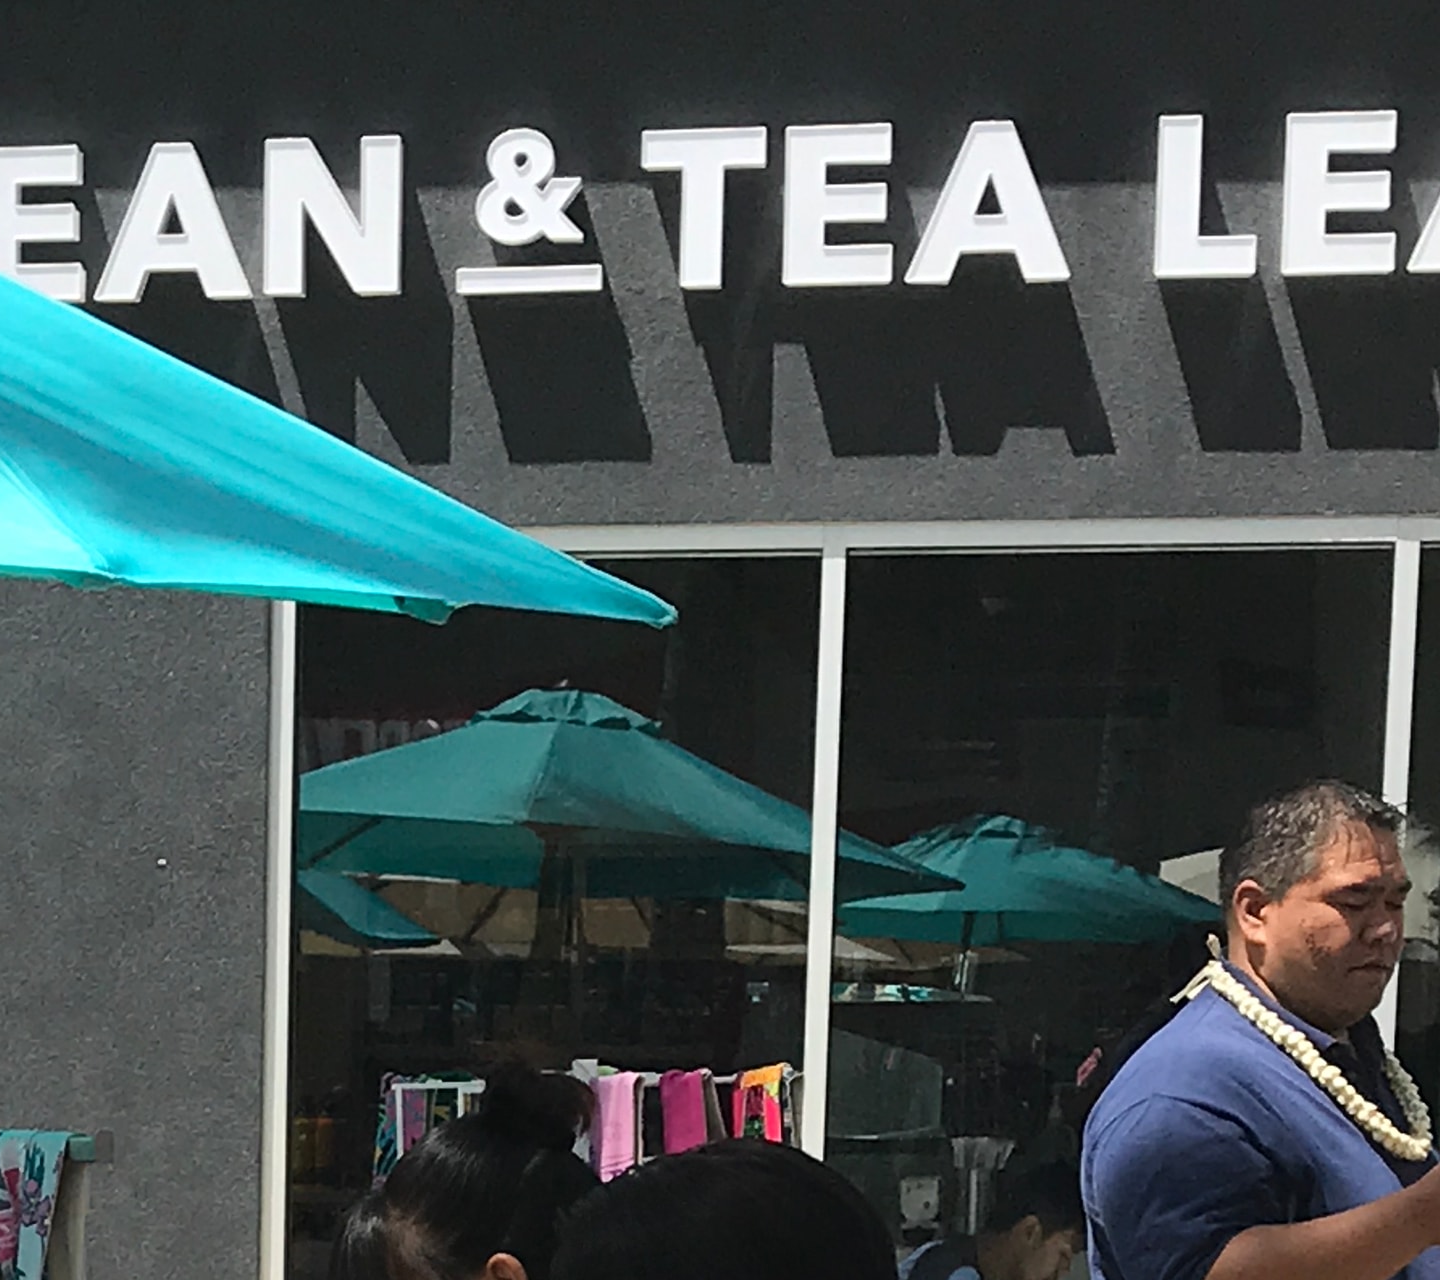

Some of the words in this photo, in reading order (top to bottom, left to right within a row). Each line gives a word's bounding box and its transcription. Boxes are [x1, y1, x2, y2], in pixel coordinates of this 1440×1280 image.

[456, 127, 603, 294] &
[641, 118, 1071, 290] TEA
[1153, 109, 1440, 279] LE
